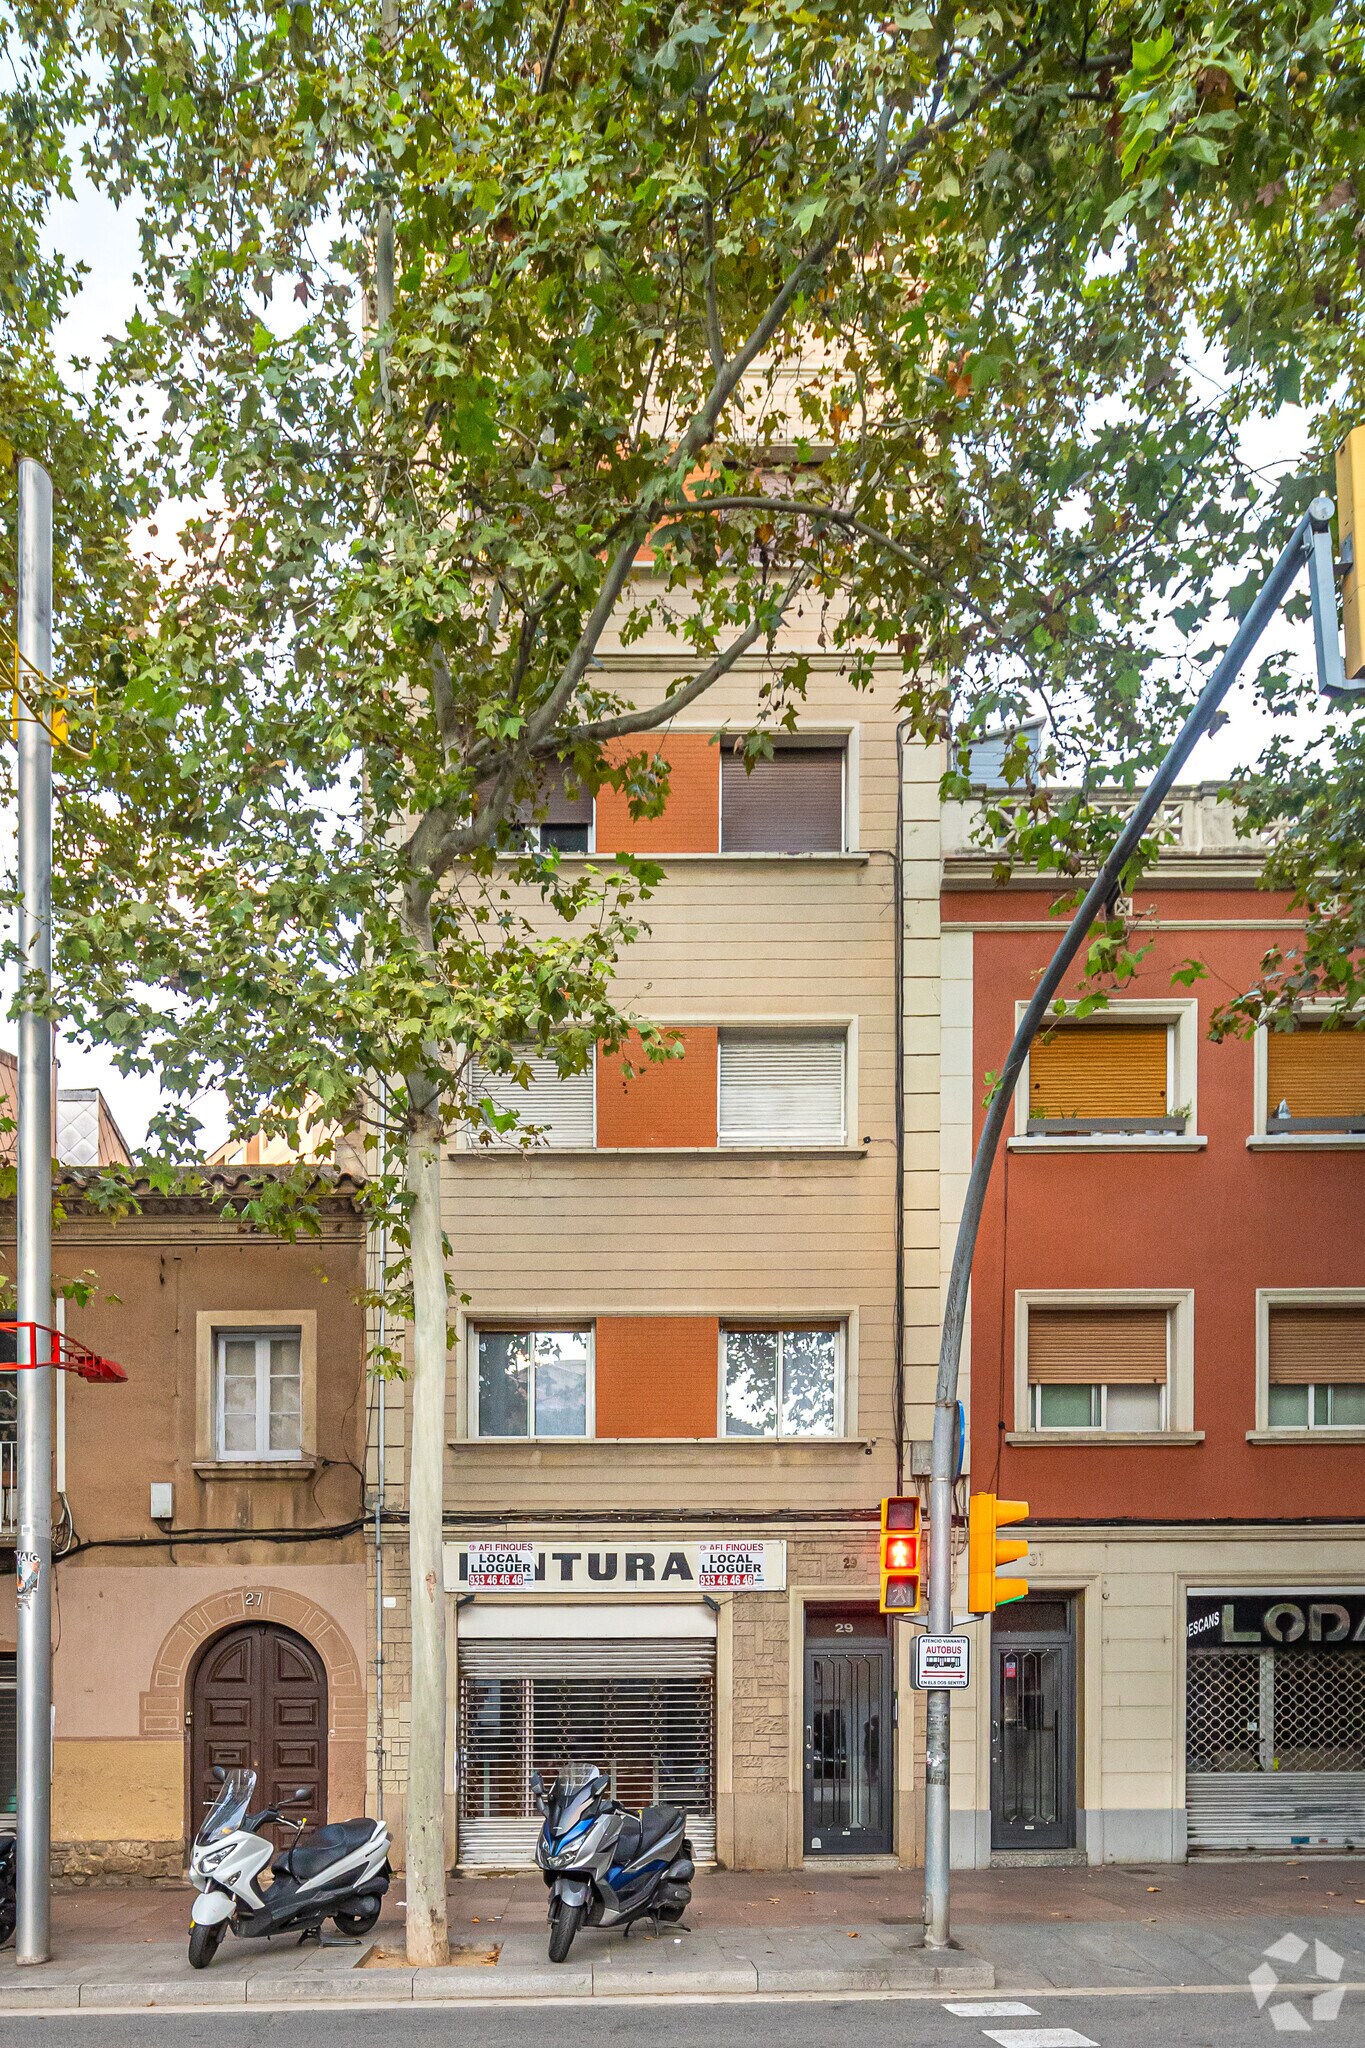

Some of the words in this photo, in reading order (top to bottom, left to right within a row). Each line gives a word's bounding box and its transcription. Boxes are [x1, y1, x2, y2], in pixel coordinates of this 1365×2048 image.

[479, 1543, 493, 1551] AFI
[495, 1543, 533, 1551] FINQUES
[709, 1543, 723, 1551] AFI
[725, 1543, 764, 1551] FINQUES
[479, 1553, 523, 1563] LOCAL
[709, 1554, 753, 1564] LOCAL
[842, 1557, 858, 1569] 29
[1028, 1551, 1044, 1567] 31
[471, 1564, 532, 1573] LLOGUER
[701, 1564, 762, 1574] LLOGUER
[469, 1575, 485, 1585] 933
[486, 1575, 498, 1585] 46
[499, 1575, 511, 1585] 46
[512, 1575, 523, 1585] 46
[700, 1575, 716, 1586] 933
[717, 1575, 728, 1586] 46
[730, 1575, 741, 1585] 46
[742, 1575, 753, 1585] 46
[245, 1592, 263, 1606] 27
[834, 1623, 854, 1633] 29
[1186, 1610, 1220, 1638] ESCANS
[926, 1645, 962, 1654] AUTOBUS
